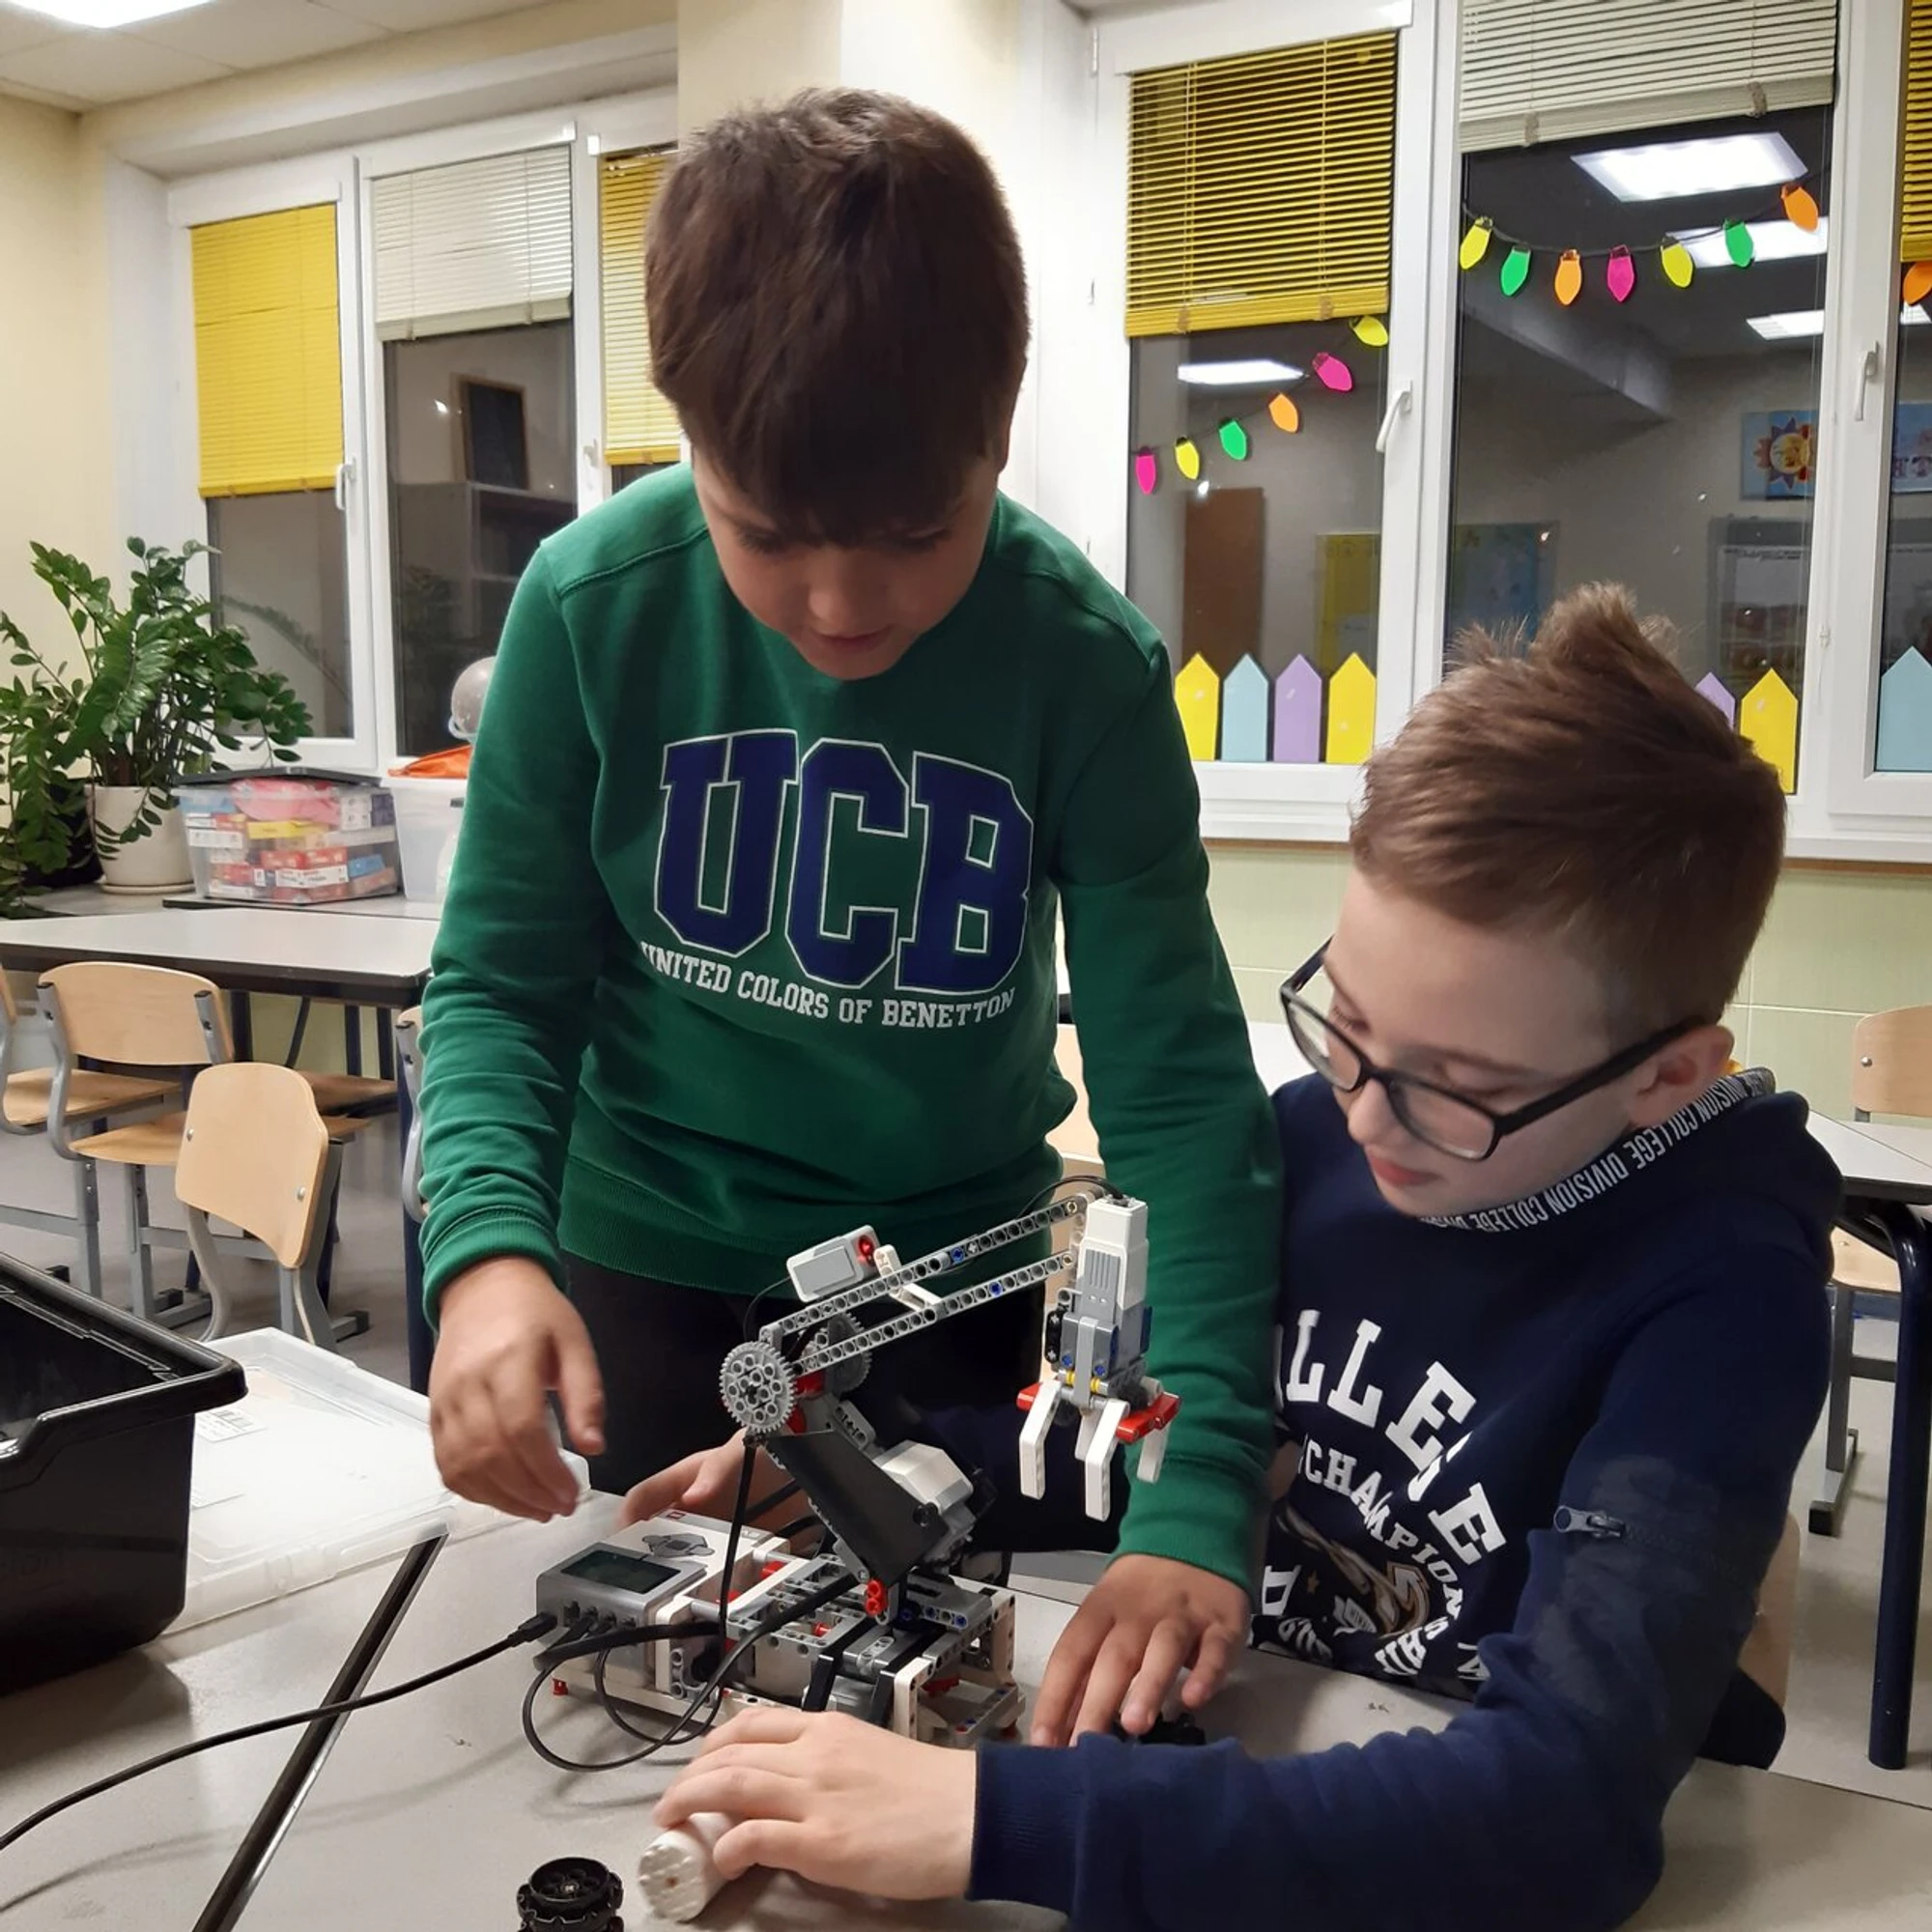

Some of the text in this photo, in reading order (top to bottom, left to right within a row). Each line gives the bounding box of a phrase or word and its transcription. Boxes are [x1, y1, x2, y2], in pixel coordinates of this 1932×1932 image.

[654, 728, 1034, 995] UCB
[640, 941, 1016, 1028] UNITED COLORS OF BENETTON
[1549, 1152, 1630, 1216] DIVISION
